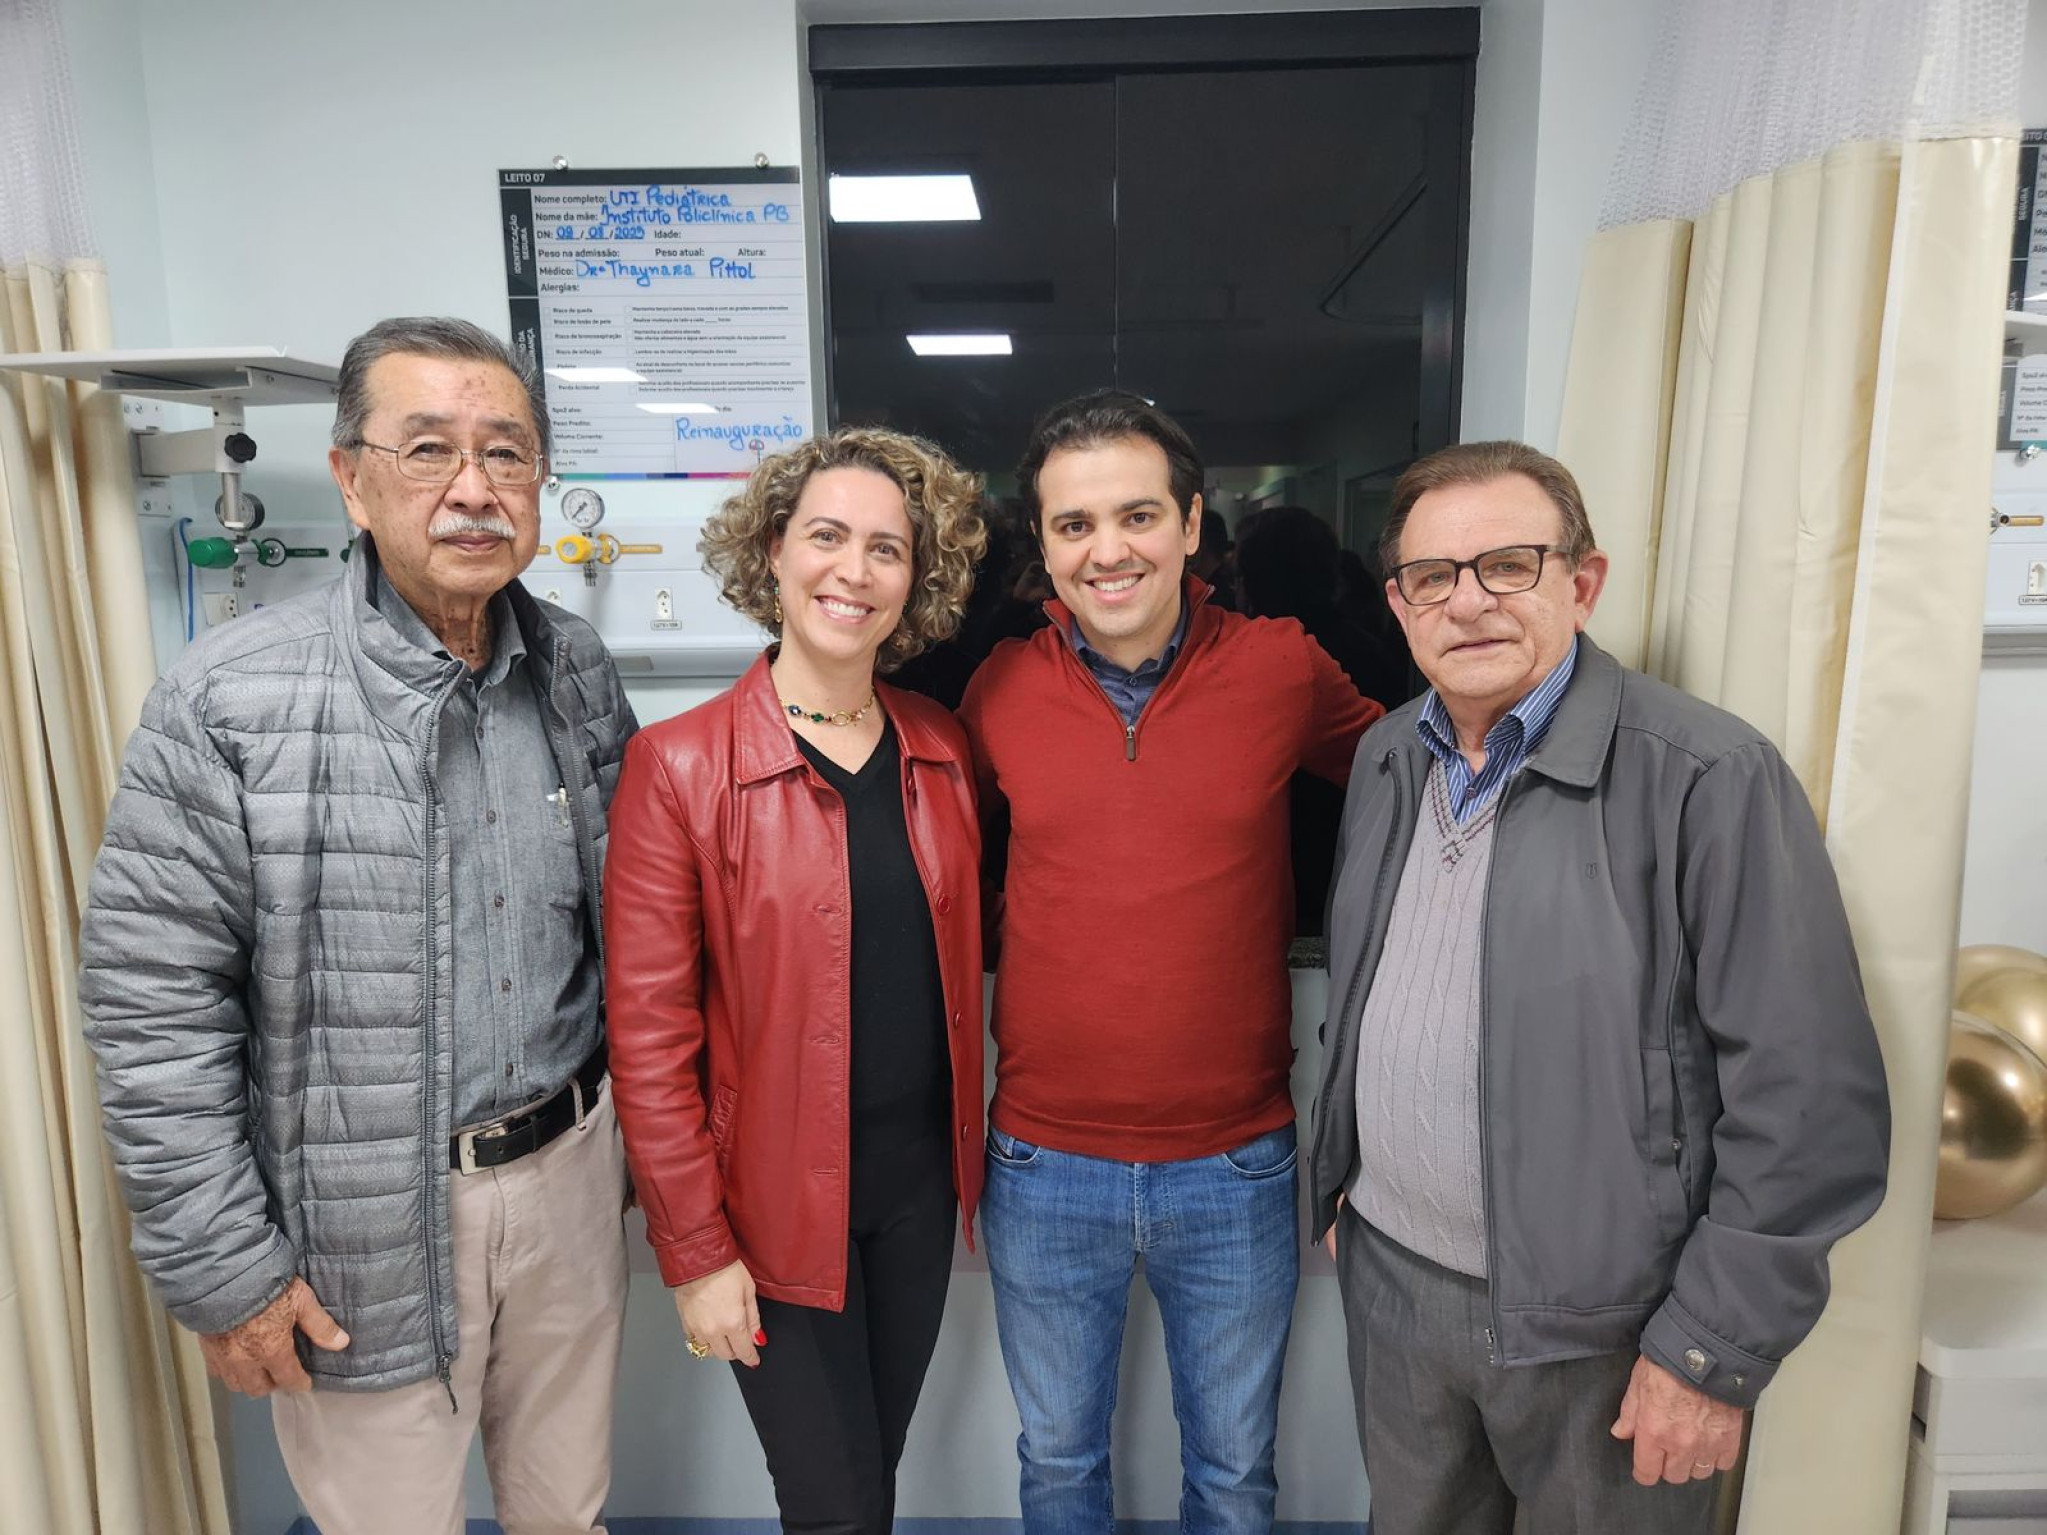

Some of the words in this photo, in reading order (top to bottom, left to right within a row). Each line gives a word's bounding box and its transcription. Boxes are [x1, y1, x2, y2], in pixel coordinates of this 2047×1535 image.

[504, 173, 531, 183] LEITO
[532, 173, 545, 183] 07
[534, 195, 560, 203] Nome
[562, 194, 607, 206] completo:
[610, 190, 640, 206] UTI
[647, 185, 729, 206] Pediátrica
[536, 213, 564, 221] Nome
[565, 213, 574, 221] da
[576, 213, 598, 221] mãe:
[600, 204, 670, 225] Instituto
[678, 204, 755, 223] Policlínica
[537, 230, 553, 239] DN:
[654, 229, 681, 239] Idade:
[509, 214, 522, 274] IDENTIFICAÇÃO
[520, 227, 530, 260] SEGURA
[538, 249, 560, 258] Peso
[562, 250, 573, 258] na
[575, 248, 620, 258] admissão:
[655, 249, 677, 257] Peso
[679, 247, 705, 257] atual:
[738, 248, 766, 257] Altura:
[539, 266, 574, 276] Médico:
[540, 283, 580, 293] Alergias:
[676, 416, 803, 450] Reinauguração
